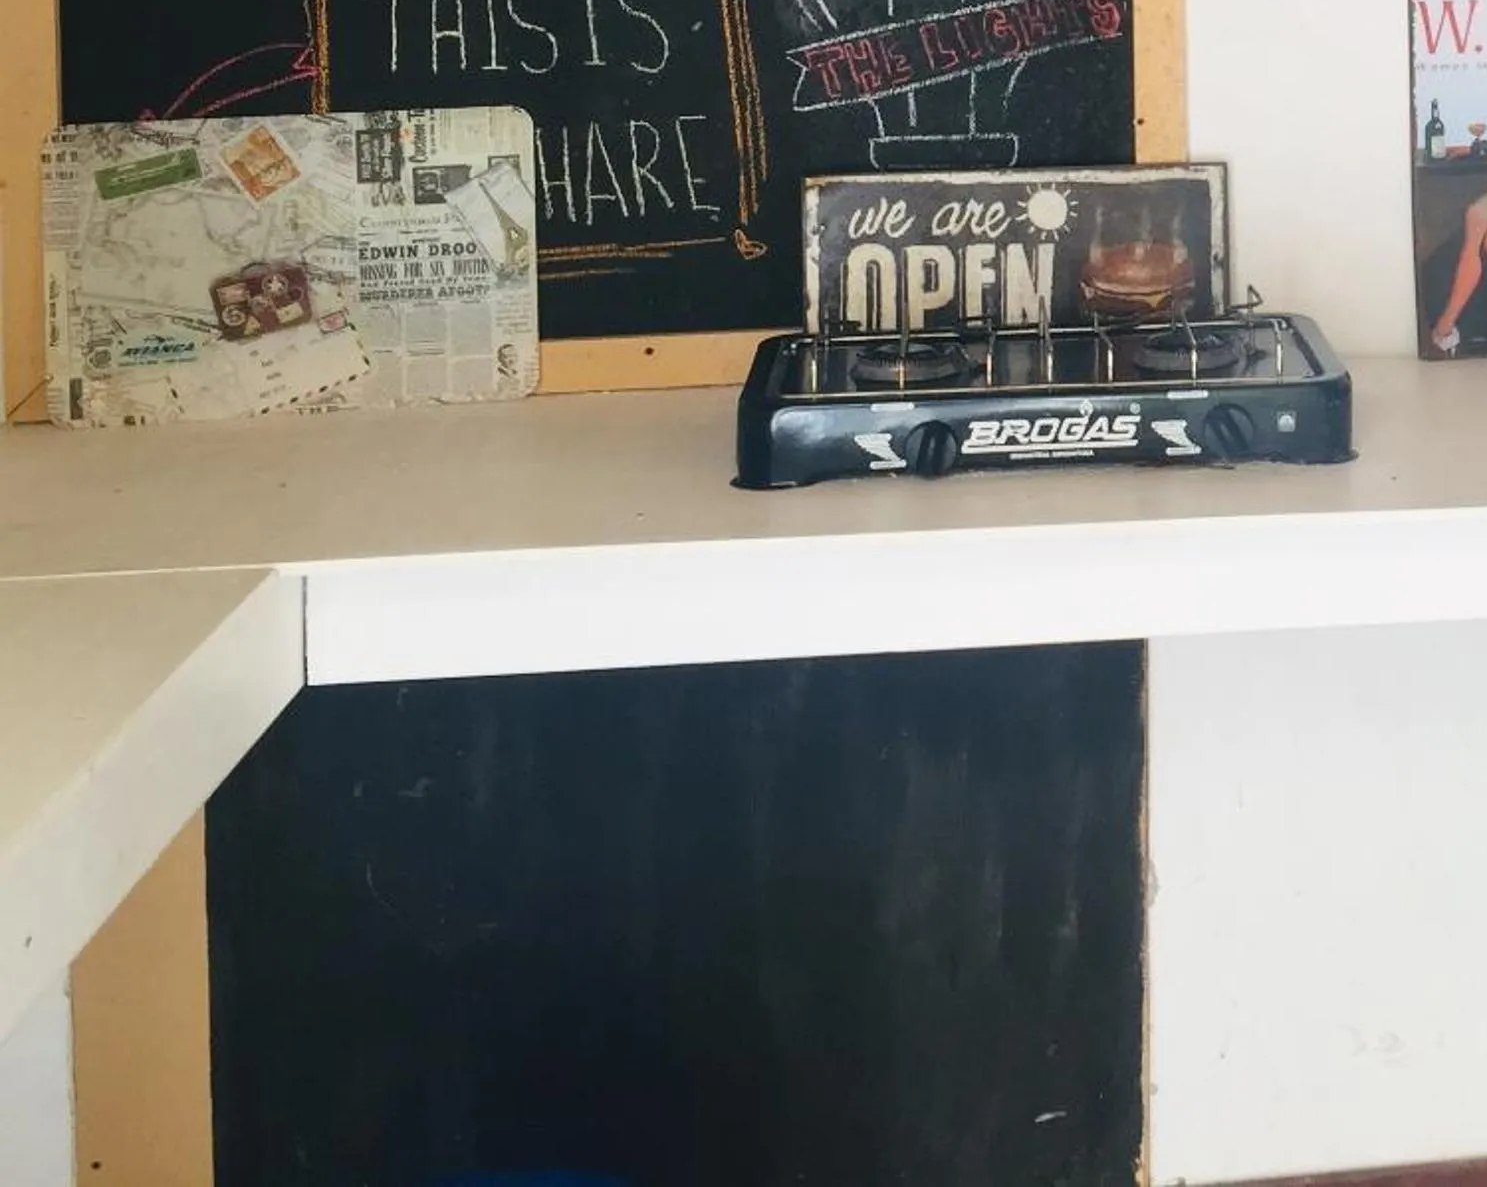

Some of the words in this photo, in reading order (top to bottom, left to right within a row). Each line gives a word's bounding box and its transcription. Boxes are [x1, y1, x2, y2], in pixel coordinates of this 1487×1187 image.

[804, 33, 913, 99] THE
[848, 194, 917, 240] we
[931, 197, 1013, 239] are
[358, 244, 420, 260] EDWIN
[840, 242, 1056, 333] OPEN
[966, 414, 1142, 447] BROGAS
